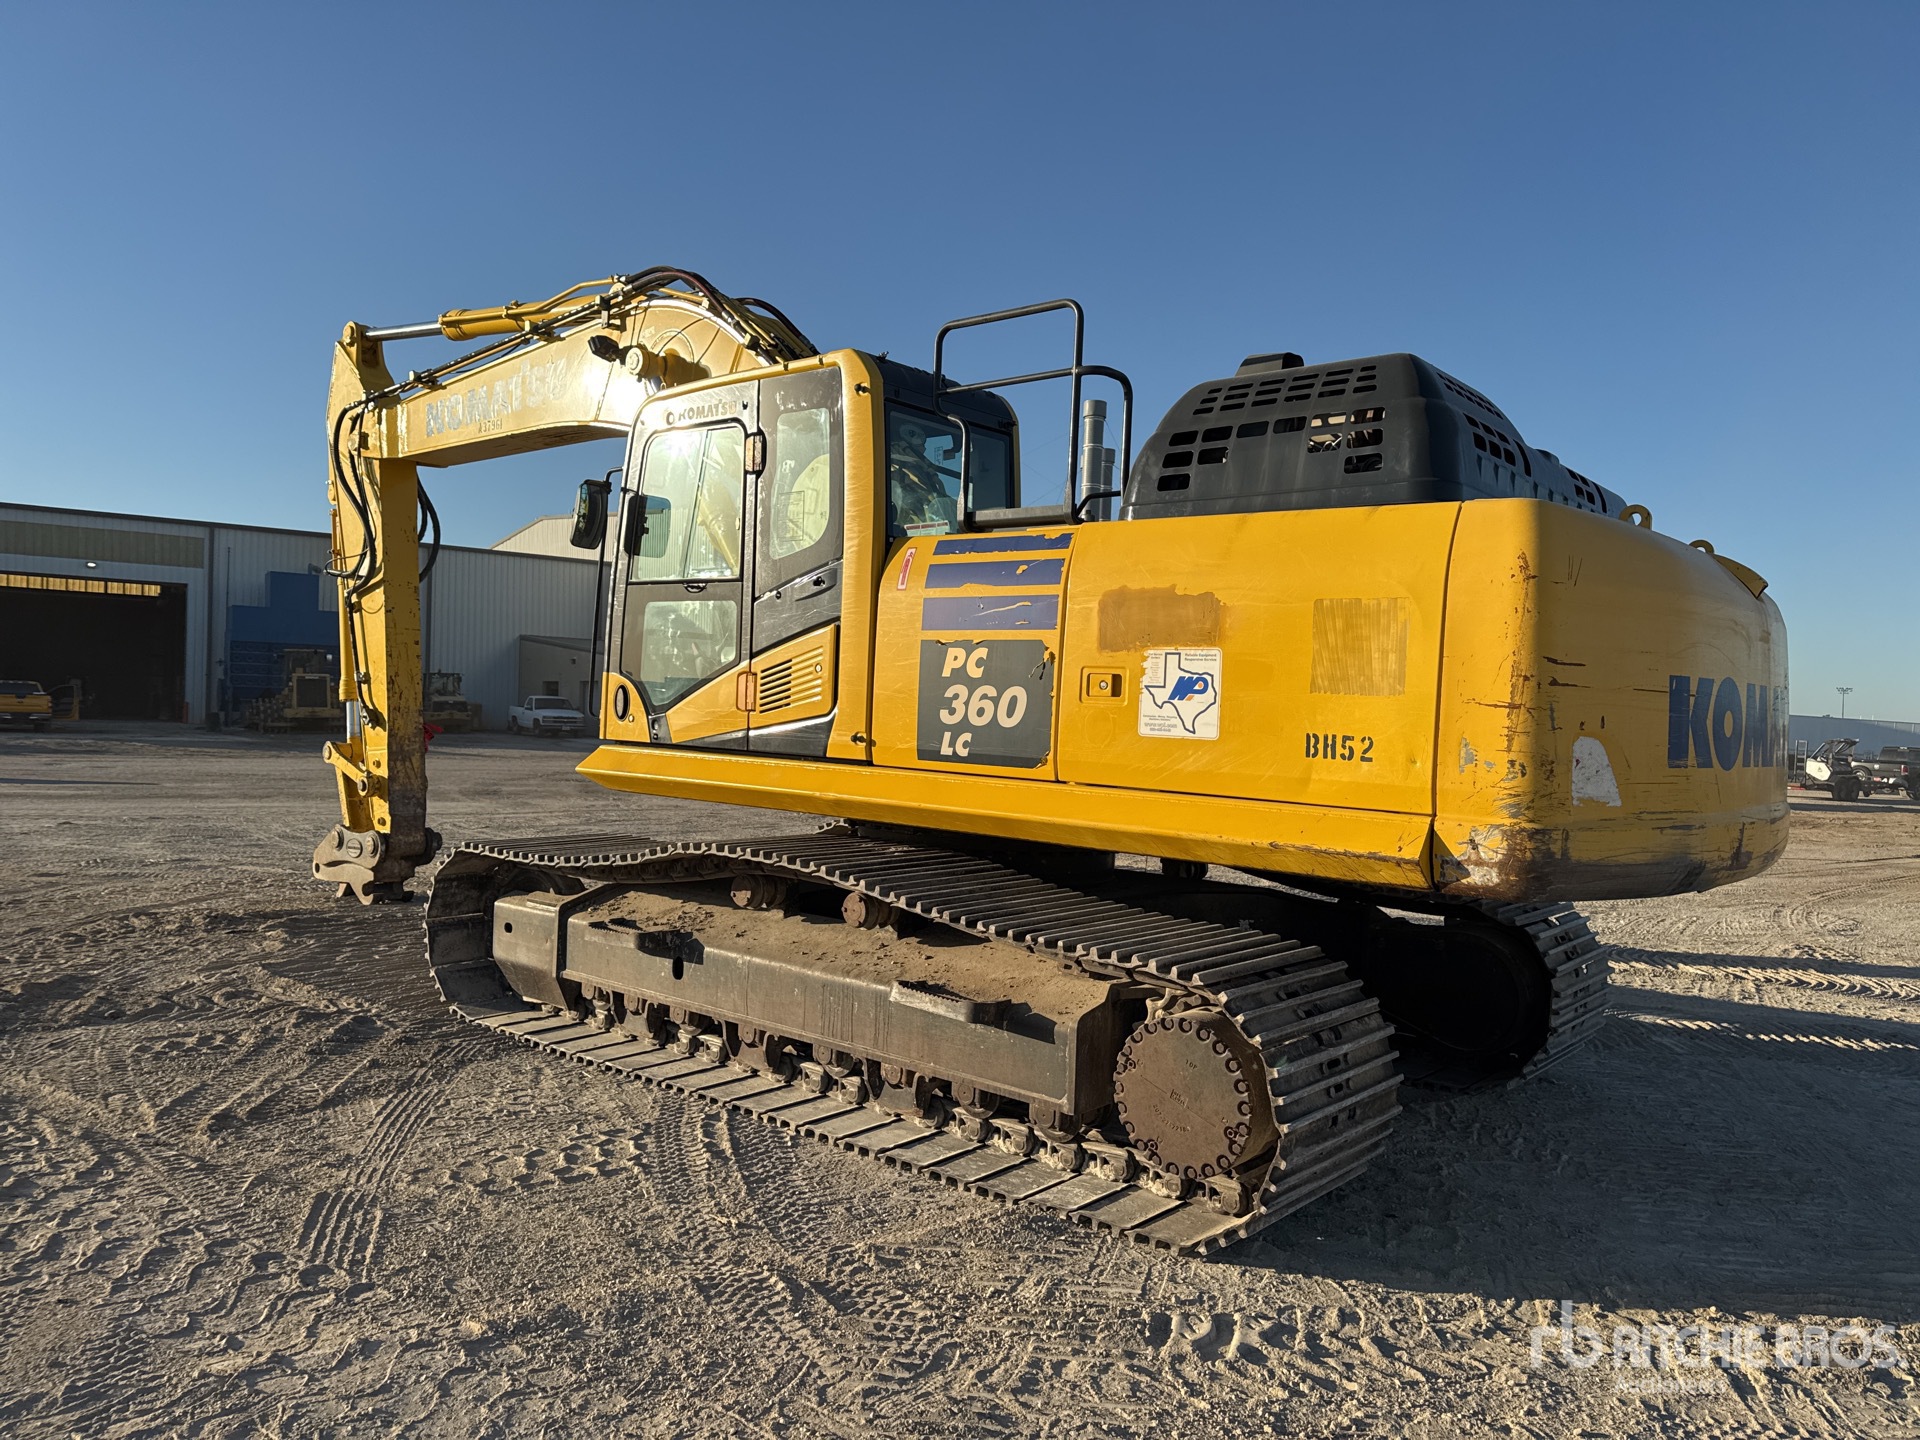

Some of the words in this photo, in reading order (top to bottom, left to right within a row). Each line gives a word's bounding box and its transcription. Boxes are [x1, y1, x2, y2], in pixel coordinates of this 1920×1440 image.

[678, 400, 737, 421] KOMATSU
[941, 647, 989, 678] PC
[939, 684, 1028, 728] 360
[940, 731, 973, 757] LC
[1305, 732, 1374, 762] BH52
